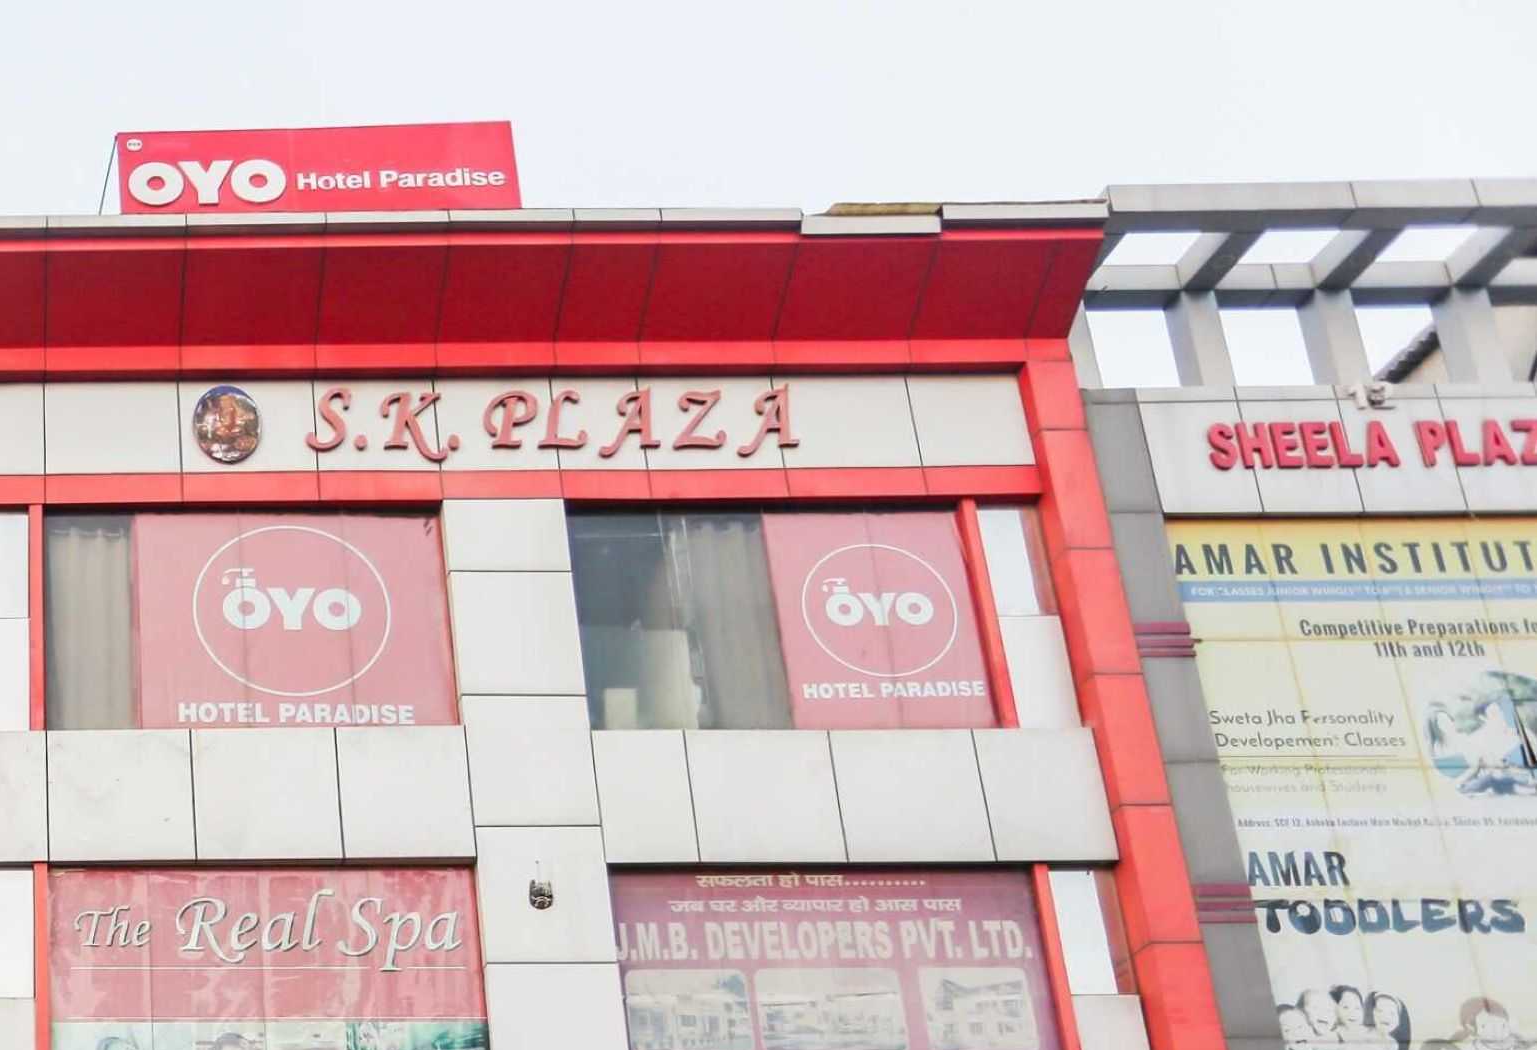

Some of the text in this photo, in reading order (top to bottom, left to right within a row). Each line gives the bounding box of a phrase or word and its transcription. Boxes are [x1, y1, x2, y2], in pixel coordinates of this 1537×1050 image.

[128, 159, 506, 206] OYO Hotel Paradise
[1207, 420, 1400, 471] SHEELA
[1175, 543, 1298, 576] AMAR
[223, 584, 362, 631] OYO
[825, 590, 934, 627] OYO
[1300, 618, 1519, 639] Competitive Preparations
[1374, 639, 1485, 657] 11th and 12th
[803, 680, 986, 699] HOTEL PARADISE
[178, 702, 415, 725] HOTEL PARADISE
[1209, 710, 1263, 725] Sweta
[1266, 710, 1296, 727] Jha
[1344, 733, 1406, 748] Classes
[1247, 851, 1351, 888] AMAR
[74, 889, 463, 973] The Real Spa
[1254, 898, 1526, 936] TODDLERS
[704, 921, 893, 961] DEVELOPERS
[900, 919, 962, 961] PVT.
[968, 919, 1034, 960] LTD.
